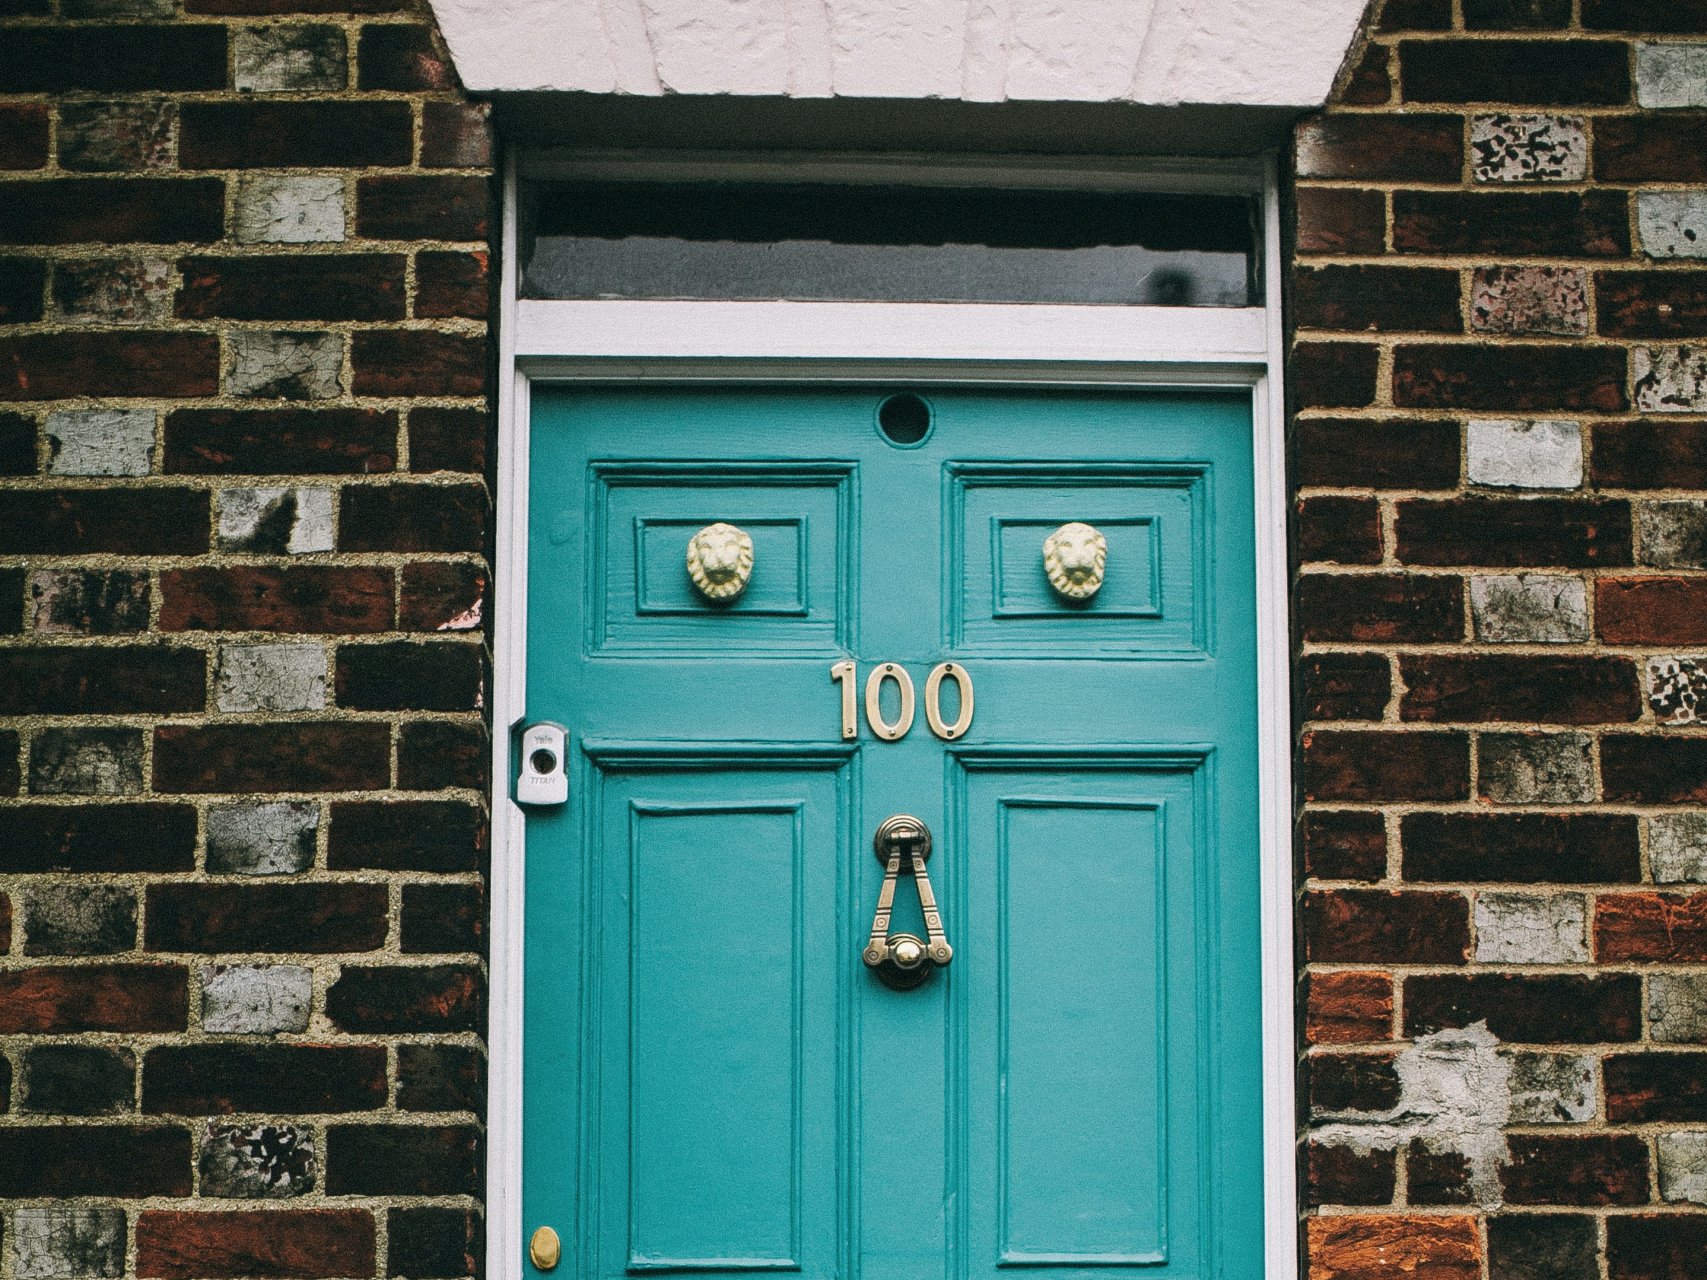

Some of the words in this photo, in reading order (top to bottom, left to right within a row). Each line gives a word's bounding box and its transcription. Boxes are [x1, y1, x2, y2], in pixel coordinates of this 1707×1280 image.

[830, 661, 974, 740] 100
[533, 735, 553, 745] Yale
[530, 776, 556, 785] TITAN
